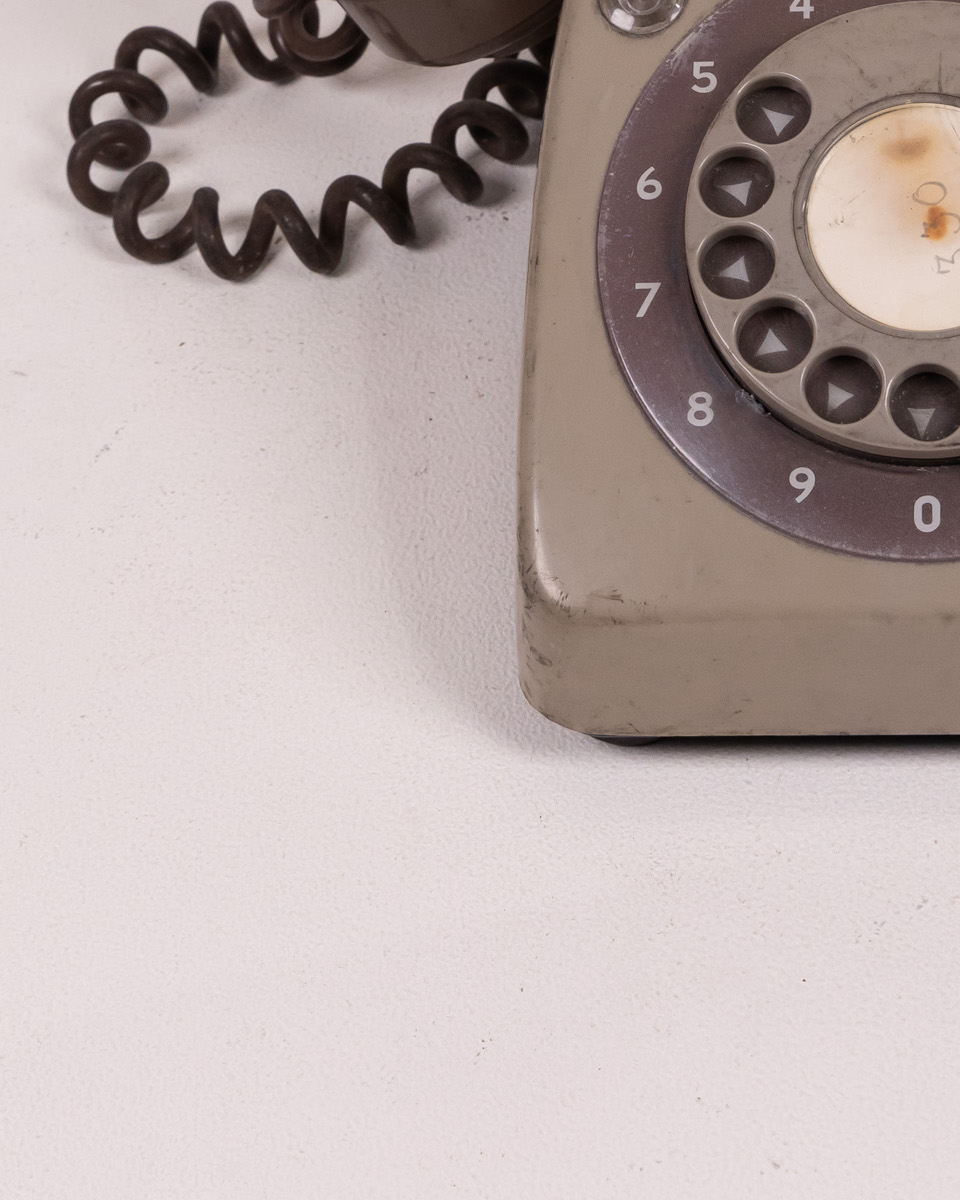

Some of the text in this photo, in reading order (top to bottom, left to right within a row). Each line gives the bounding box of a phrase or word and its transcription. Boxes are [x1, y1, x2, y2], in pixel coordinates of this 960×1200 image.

[691, 61, 717, 93] 5
[636, 166, 662, 200] 6
[635, 282, 660, 318] 7
[687, 391, 714, 427] 8
[789, 467, 816, 503] 9
[913, 495, 941, 533] 0
